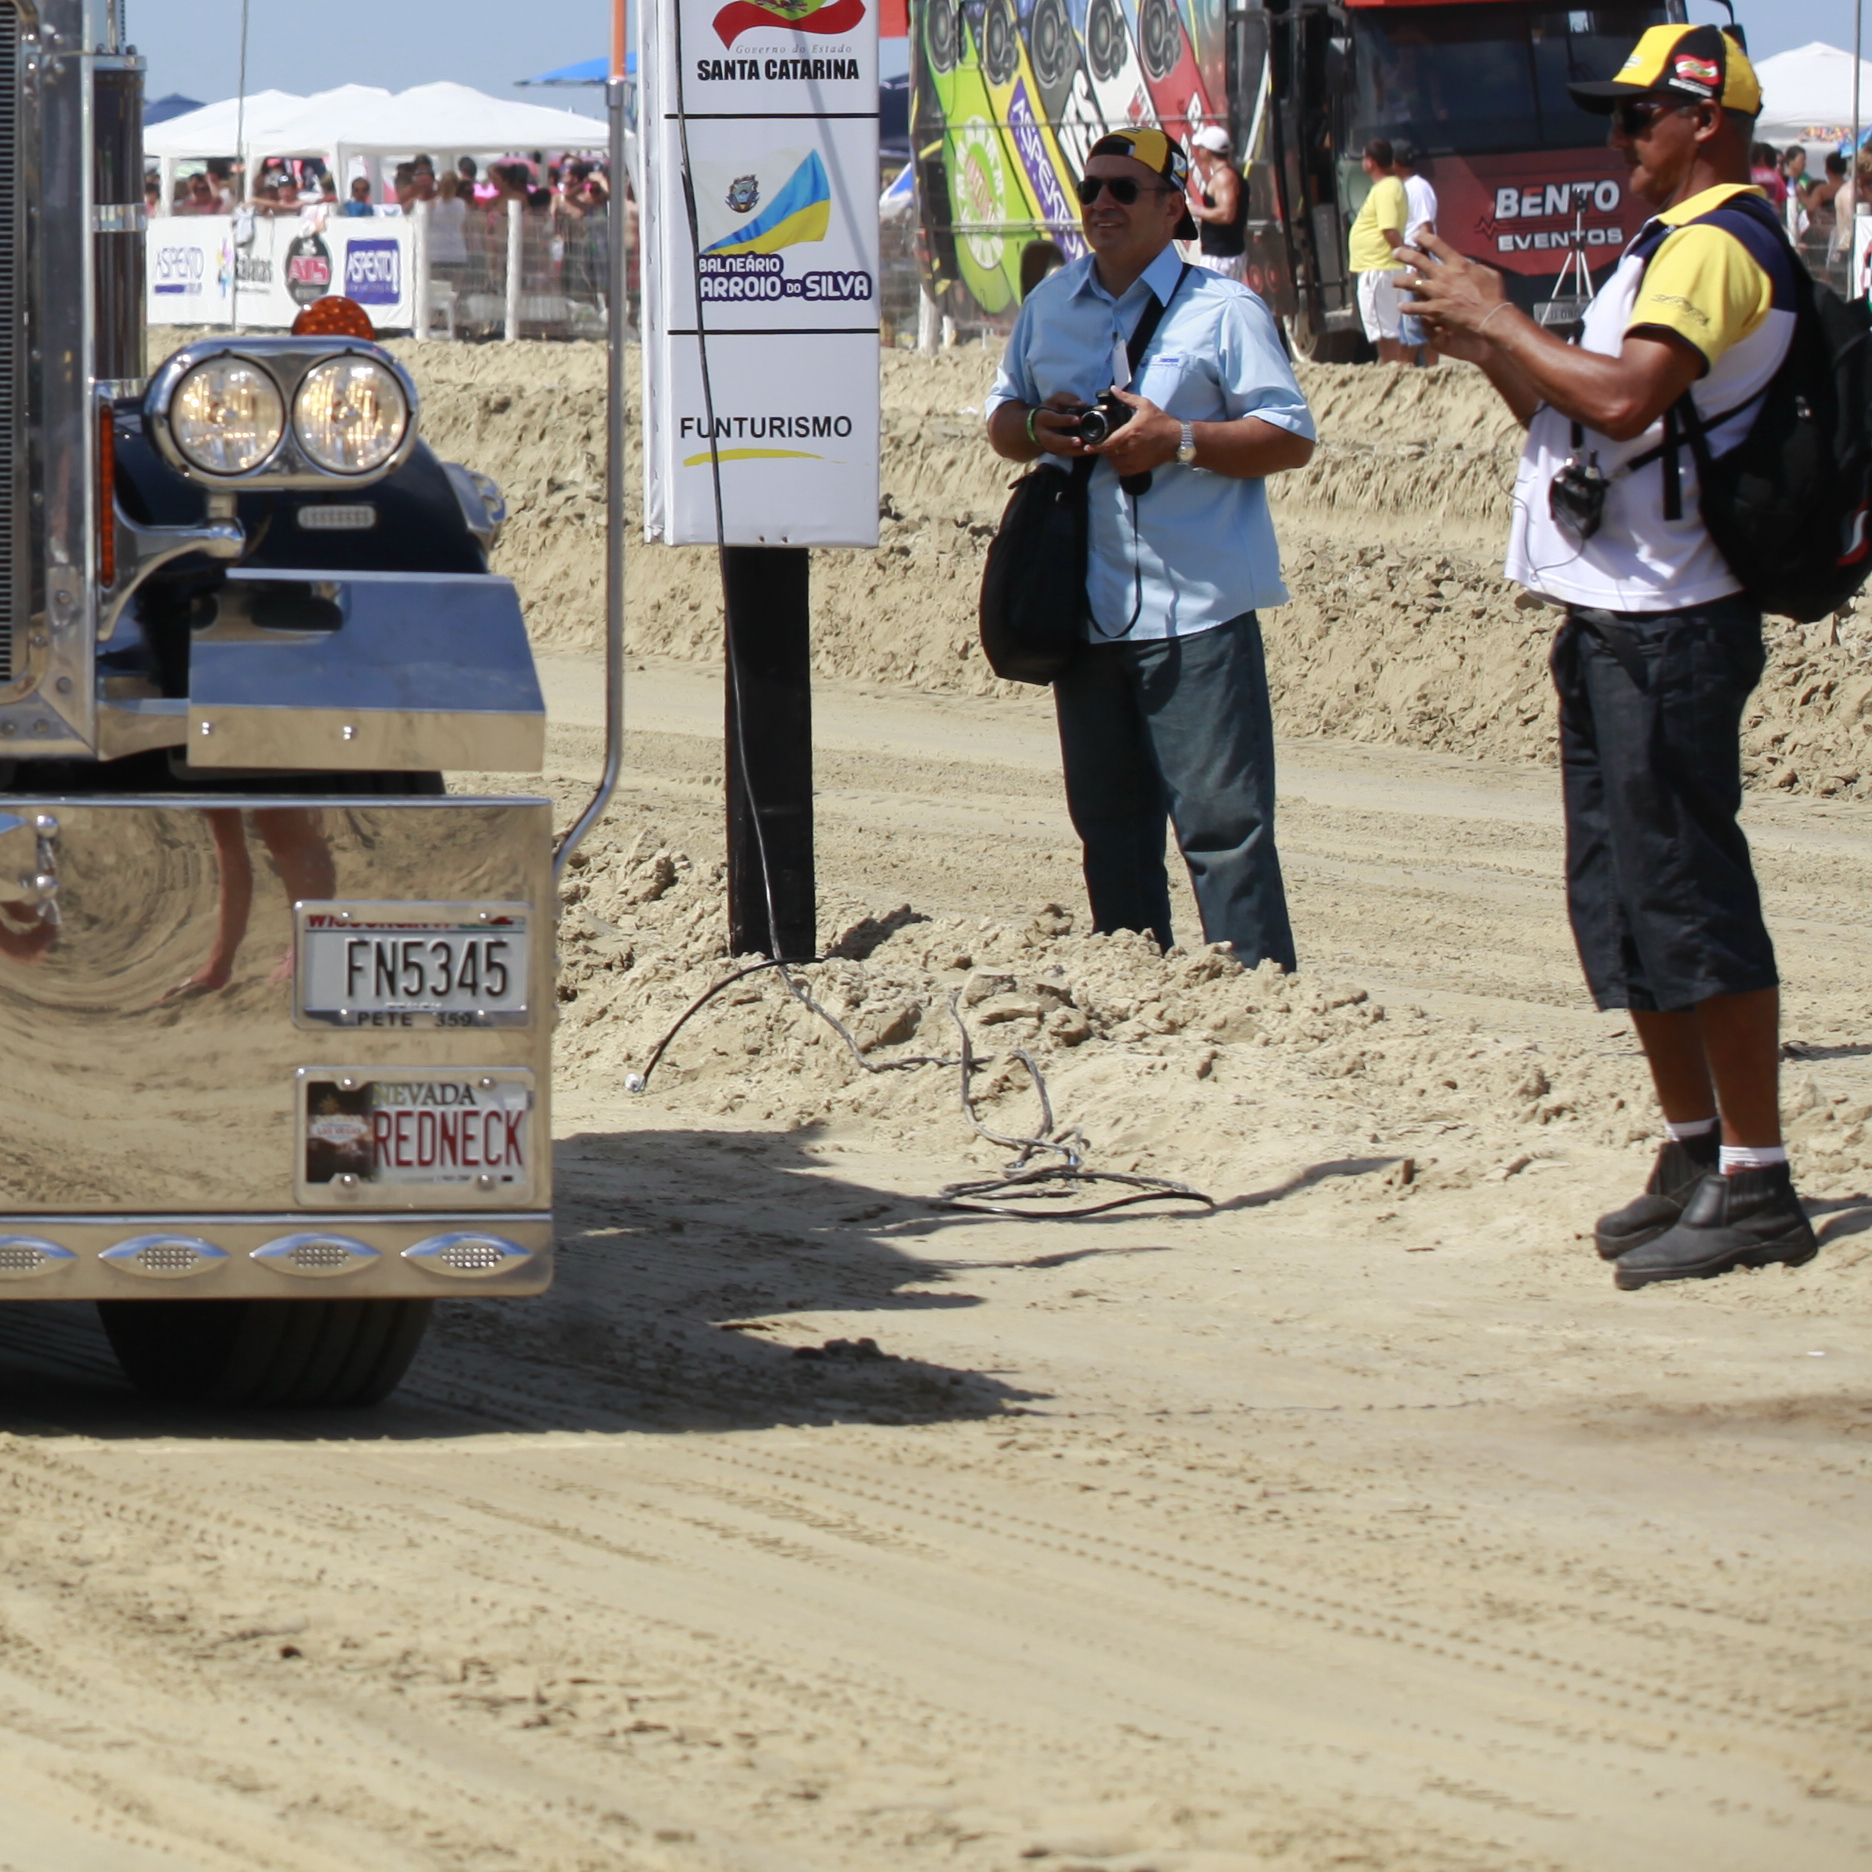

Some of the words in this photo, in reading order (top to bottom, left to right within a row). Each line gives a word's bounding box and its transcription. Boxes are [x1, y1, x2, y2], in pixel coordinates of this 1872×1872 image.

[736, 44, 786, 54] Governo
[792, 44, 806, 54] do
[812, 44, 852, 54] Estado
[697, 59, 760, 81] SANTA
[764, 58, 859, 81] CATARINA
[1495, 180, 1620, 220] BENTO
[1497, 227, 1624, 252] EVENTOS
[699, 255, 781, 273] BALNEÁRIO
[700, 276, 781, 298] ARROIO
[786, 282, 802, 294] DO
[805, 275, 869, 298] SILVA
[680, 416, 853, 438] FUNTURISMO
[345, 939, 509, 998] FN5345
[358, 1011, 413, 1027] PETE
[435, 1011, 472, 1027] 359
[371, 1084, 477, 1106] NEVADA
[373, 1109, 524, 1167] REDNECK
